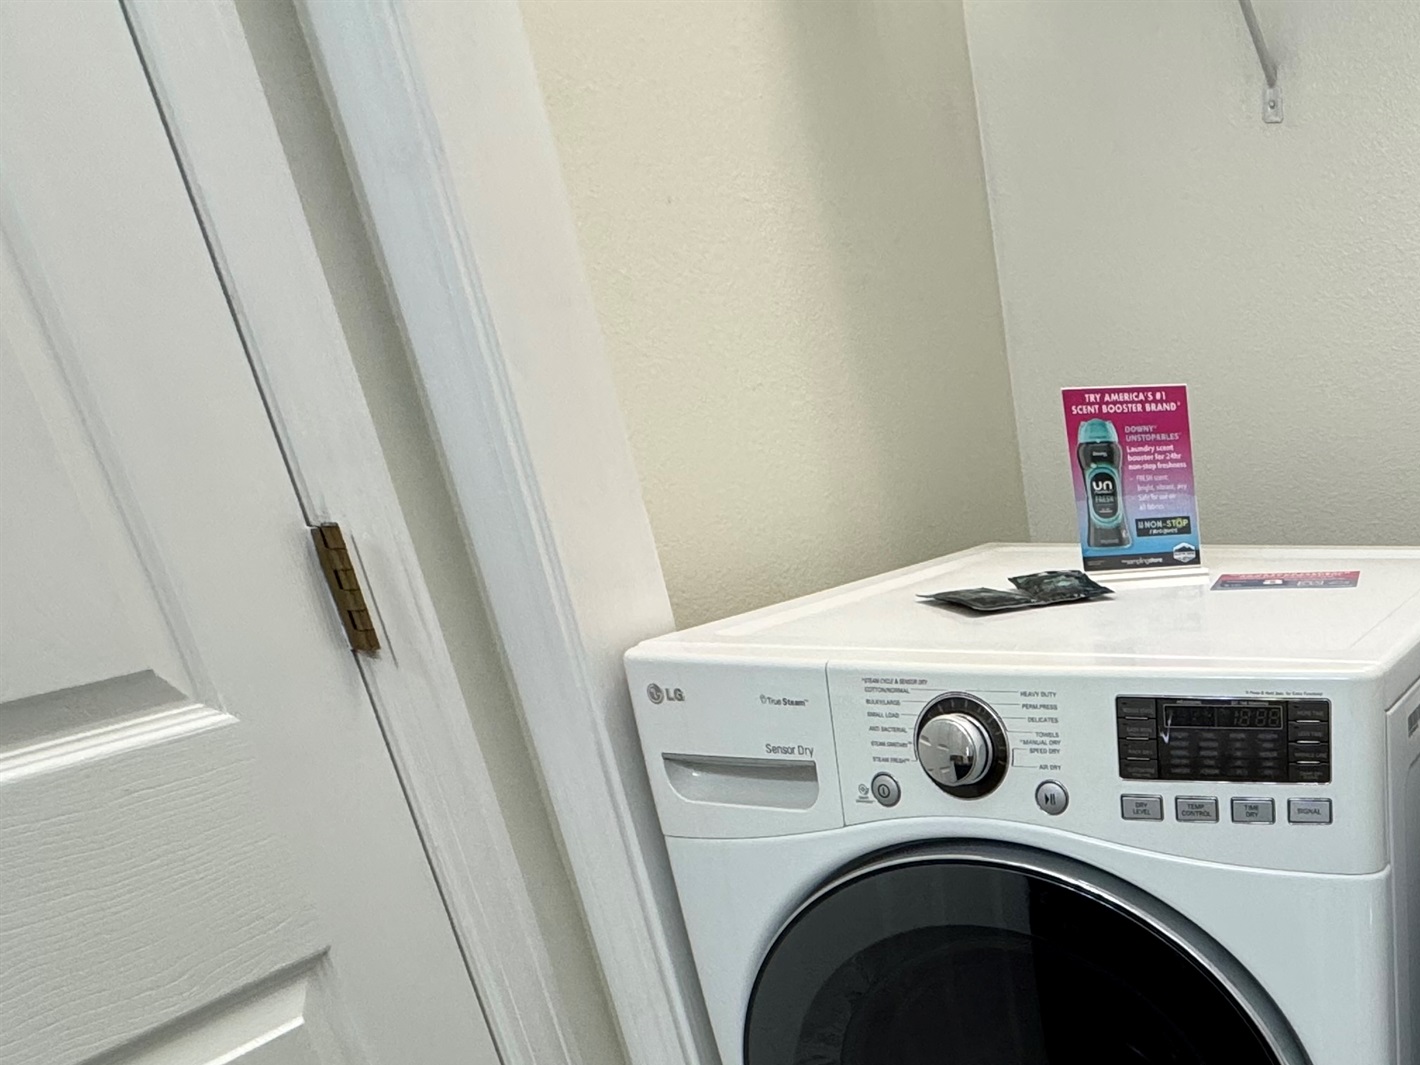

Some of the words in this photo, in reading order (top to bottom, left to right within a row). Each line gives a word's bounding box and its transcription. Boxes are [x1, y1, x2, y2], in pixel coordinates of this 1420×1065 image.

[1084, 393, 1101, 402] TRY
[1104, 391, 1154, 401] AMERICA'S
[1155, 391, 1166, 400] #1
[1071, 405, 1099, 414] SCENT
[1102, 403, 1143, 413] BOOSTER
[1126, 444, 1155, 453] Laundry
[1128, 453, 1154, 461] booster
[1128, 462, 1156, 470] non-stop
[1157, 461, 1187, 469] freshness
[1144, 518, 1189, 529] NON-STOP
[665, 687, 685, 702] LG
[765, 743, 796, 755] Sensor
[797, 745, 814, 759] Dry
[1132, 808, 1151, 816] LEVEL
[1181, 810, 1212, 818] CONTROL
[1297, 808, 1322, 816] SIGNAL
